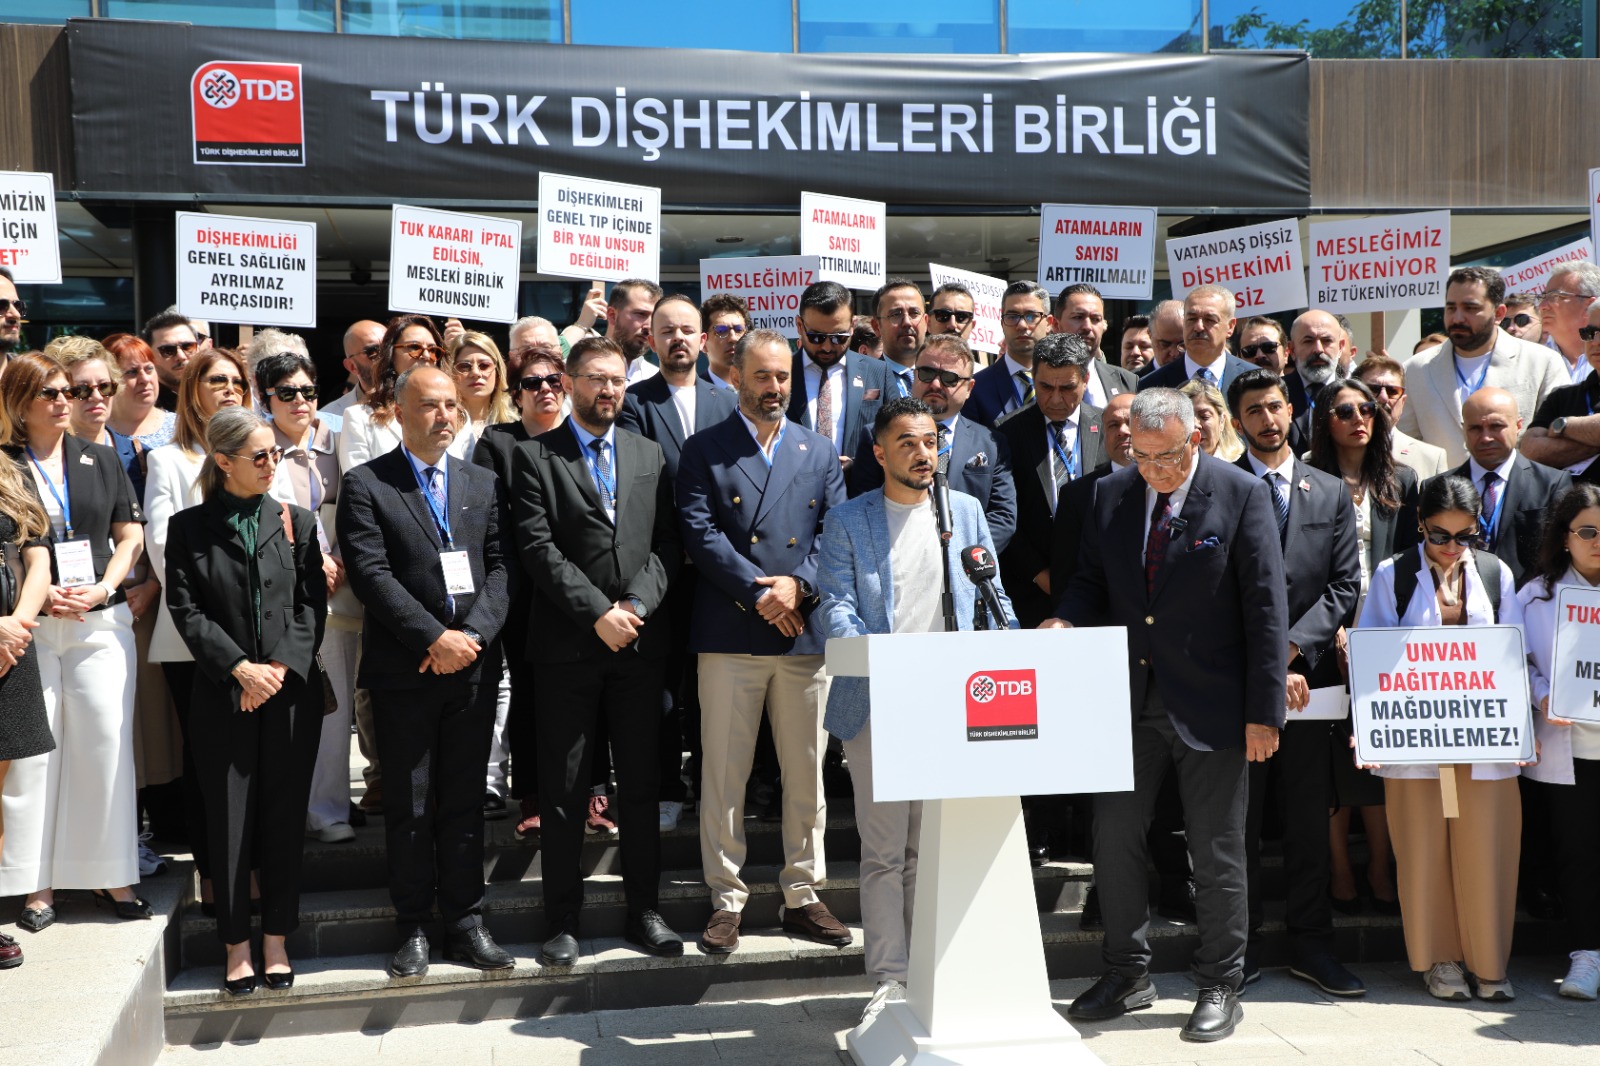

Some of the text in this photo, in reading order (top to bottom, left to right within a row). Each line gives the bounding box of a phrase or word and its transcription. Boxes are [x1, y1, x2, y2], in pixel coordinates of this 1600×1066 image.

[240, 79, 295, 101] TDB
[370, 81, 1217, 162] TÜRK DİŞHEKİMLERİ BİRLİĞİ
[200, 147, 220, 155] TÜRK
[558, 188, 644, 213] DİŞHEKİMLERİ
[2, 218, 38, 243] İÇİN
[547, 209, 653, 235] GENEL TIP İÇİNDE
[812, 208, 876, 231] ATAMALARIN
[1054, 218, 1143, 237] ATAMALARIN
[197, 228, 298, 251] DİŞHEKİMLİĞİ
[400, 220, 514, 249] TUK KARARI İPTAL
[553, 229, 645, 254] BİR YAN UNSUR
[828, 235, 861, 253] SAYISI
[1174, 228, 1293, 262] VATANDAŞ DİŞSİZ
[1316, 229, 1442, 257] MESLEĞİMİZ
[188, 250, 306, 272] GENEL SAĞLIĞIN
[433, 246, 484, 268] EDİLSİN,
[570, 251, 629, 272] DEĞİLDİR!
[1075, 245, 1119, 262] SAYISI
[407, 264, 504, 290] MESLEKİ BİRLİK
[706, 267, 814, 290] MESLEĞİMİZ
[1045, 266, 1146, 285] ARTTIRILMALI!
[1321, 255, 1437, 283] TÜKENİYOR
[211, 273, 284, 291] AYRILMAZ
[1318, 280, 1440, 303] BİZ TÜKENİYORUZ!
[201, 291, 294, 310] PARÇASIDIR!
[419, 288, 491, 309] KORUNSUN!
[1405, 641, 1477, 663] UNVAN
[992, 680, 1033, 697] TDB
[1378, 667, 1497, 692] DAĞITARAK
[1370, 694, 1508, 720] MAĞDURİYET
[1370, 723, 1520, 749] GİDERİLEMEZ!
